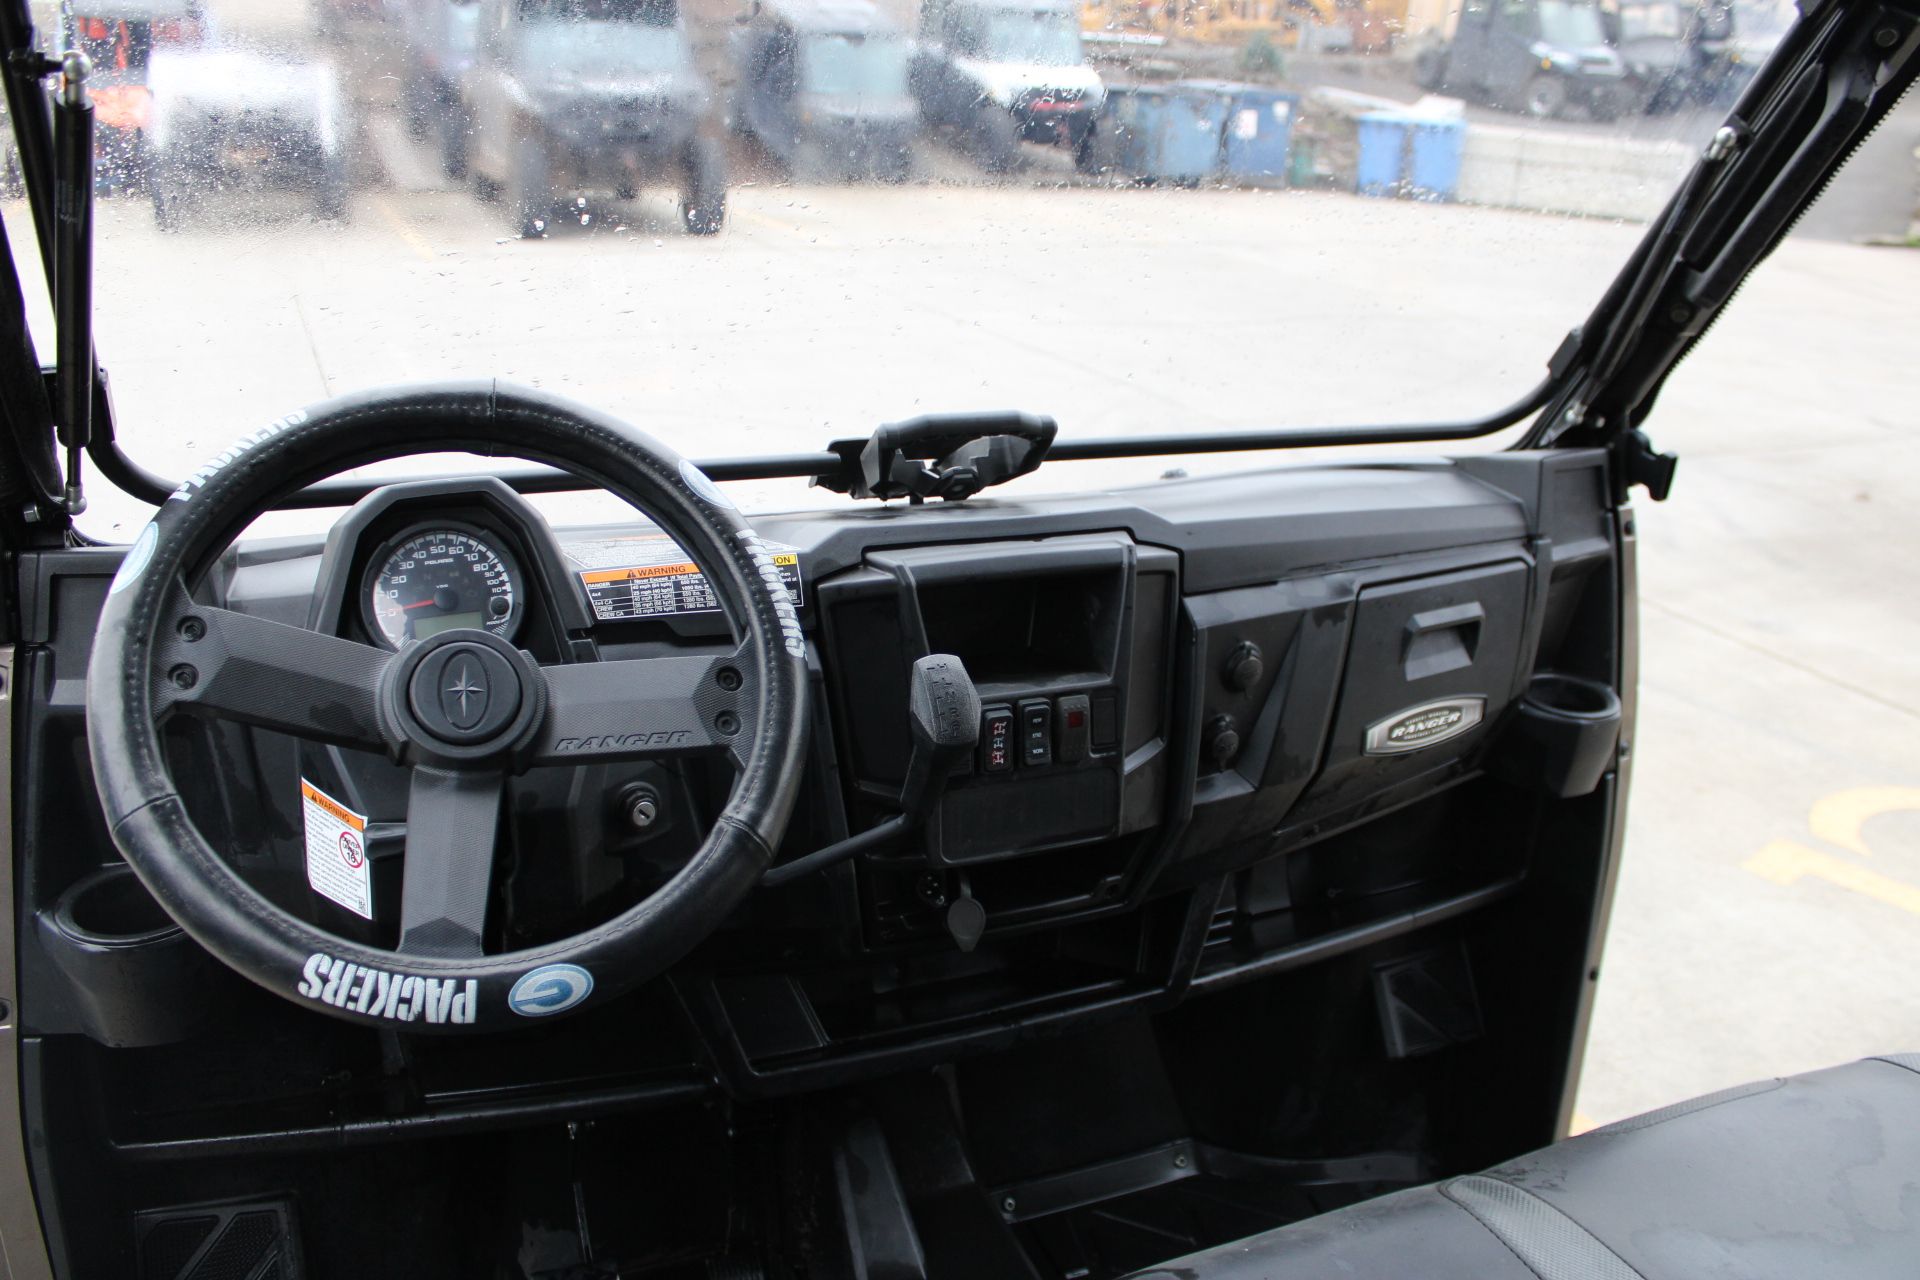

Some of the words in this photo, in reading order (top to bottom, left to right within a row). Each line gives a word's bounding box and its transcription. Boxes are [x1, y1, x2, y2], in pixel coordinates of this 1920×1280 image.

[430, 545, 446, 554] 50
[448, 546, 464, 555] 60
[412, 551, 427, 559] 40
[464, 553, 478, 562] 70
[398, 561, 414, 570] 30
[473, 563, 489, 572] 80
[638, 565, 686, 577] WARNING
[391, 575, 407, 584] 20
[386, 589, 398, 599] 10
[1391, 712, 1462, 739] RANGER
[555, 730, 692, 751] RANGER
[318, 797, 350, 823] WARNING
[298, 953, 478, 1025] PACKERS
